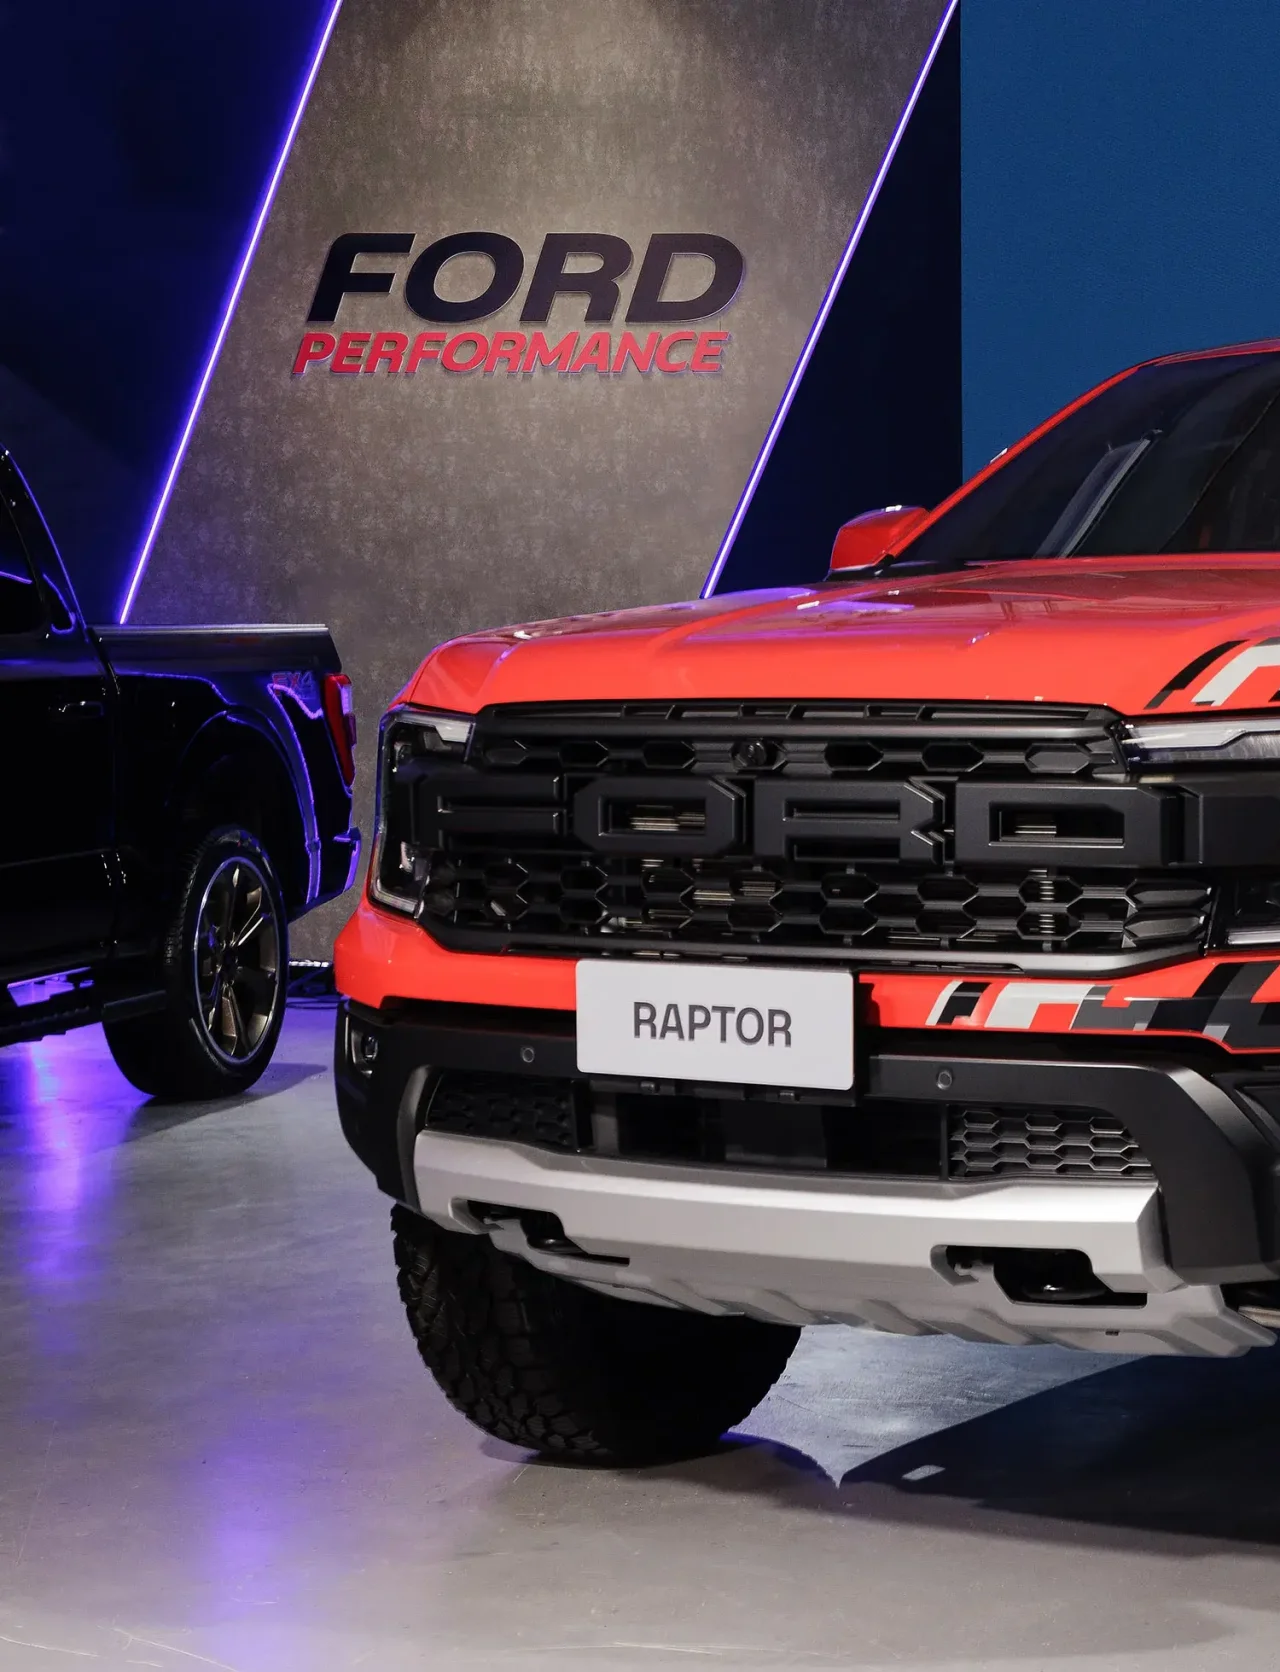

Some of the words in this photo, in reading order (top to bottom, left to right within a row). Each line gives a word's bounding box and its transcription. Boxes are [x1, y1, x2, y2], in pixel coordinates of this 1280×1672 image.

[306, 231, 747, 324] FORD
[292, 330, 731, 375] PERFORMANCE
[271, 671, 314, 697] FX4
[416, 773, 1168, 868] FORD
[633, 1001, 792, 1048] RAPTOR
